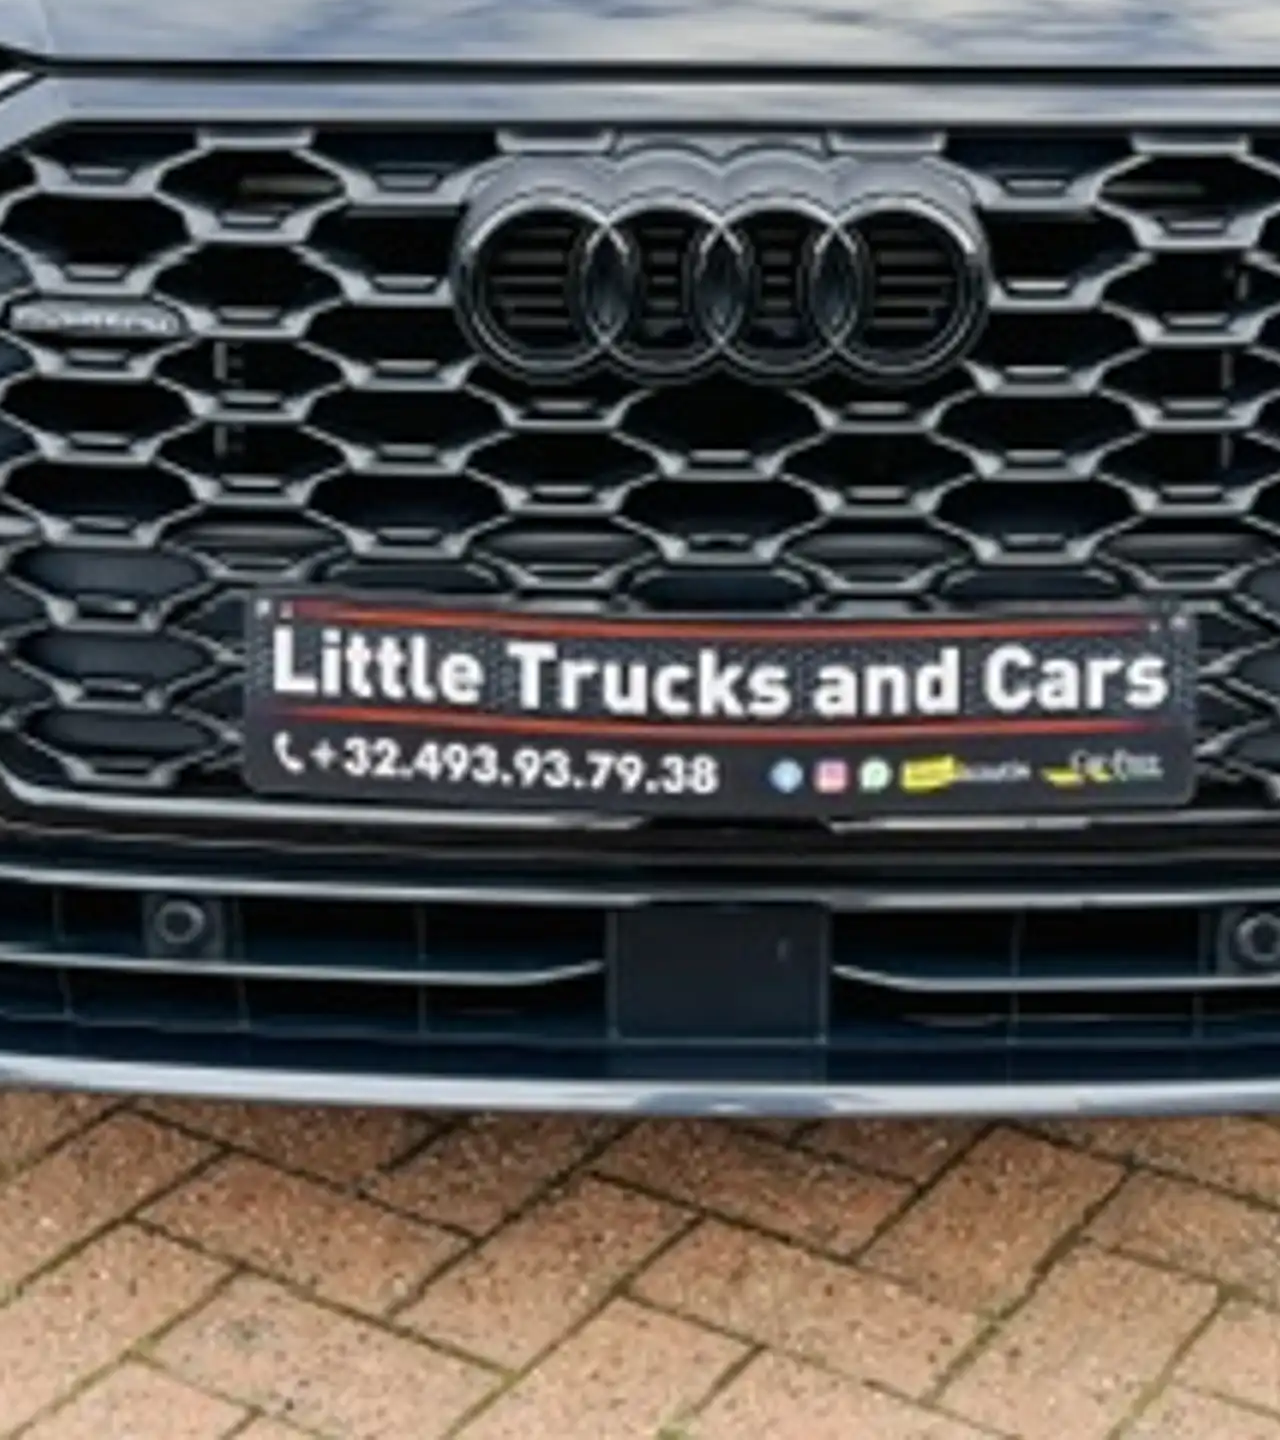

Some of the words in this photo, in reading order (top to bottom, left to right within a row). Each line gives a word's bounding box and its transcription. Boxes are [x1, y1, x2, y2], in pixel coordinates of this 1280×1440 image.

[272, 625, 486, 705] Little
[506, 639, 792, 718] Trucks
[812, 646, 961, 717] and
[983, 643, 1169, 713] Cars
[310, 735, 720, 795] +32.493.93.79.38
